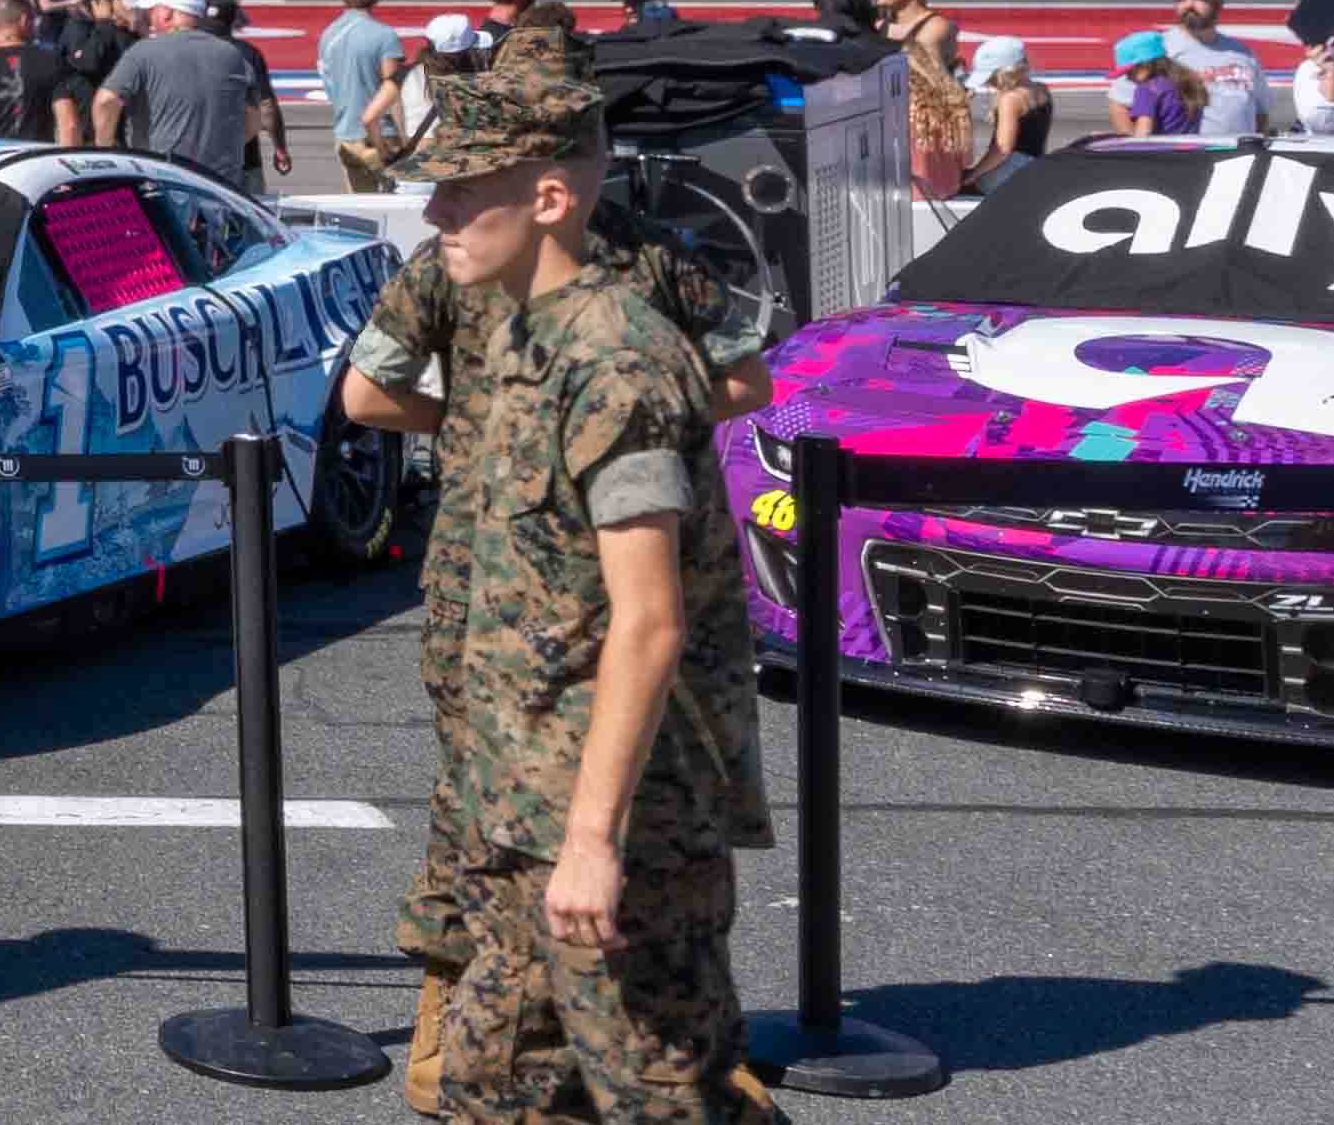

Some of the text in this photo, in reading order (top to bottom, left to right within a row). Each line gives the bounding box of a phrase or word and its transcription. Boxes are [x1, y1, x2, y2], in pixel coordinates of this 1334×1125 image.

[1042, 154, 1334, 291] all
[101, 284, 268, 435] BUSCH
[1182, 467, 1266, 493] Hendrick
